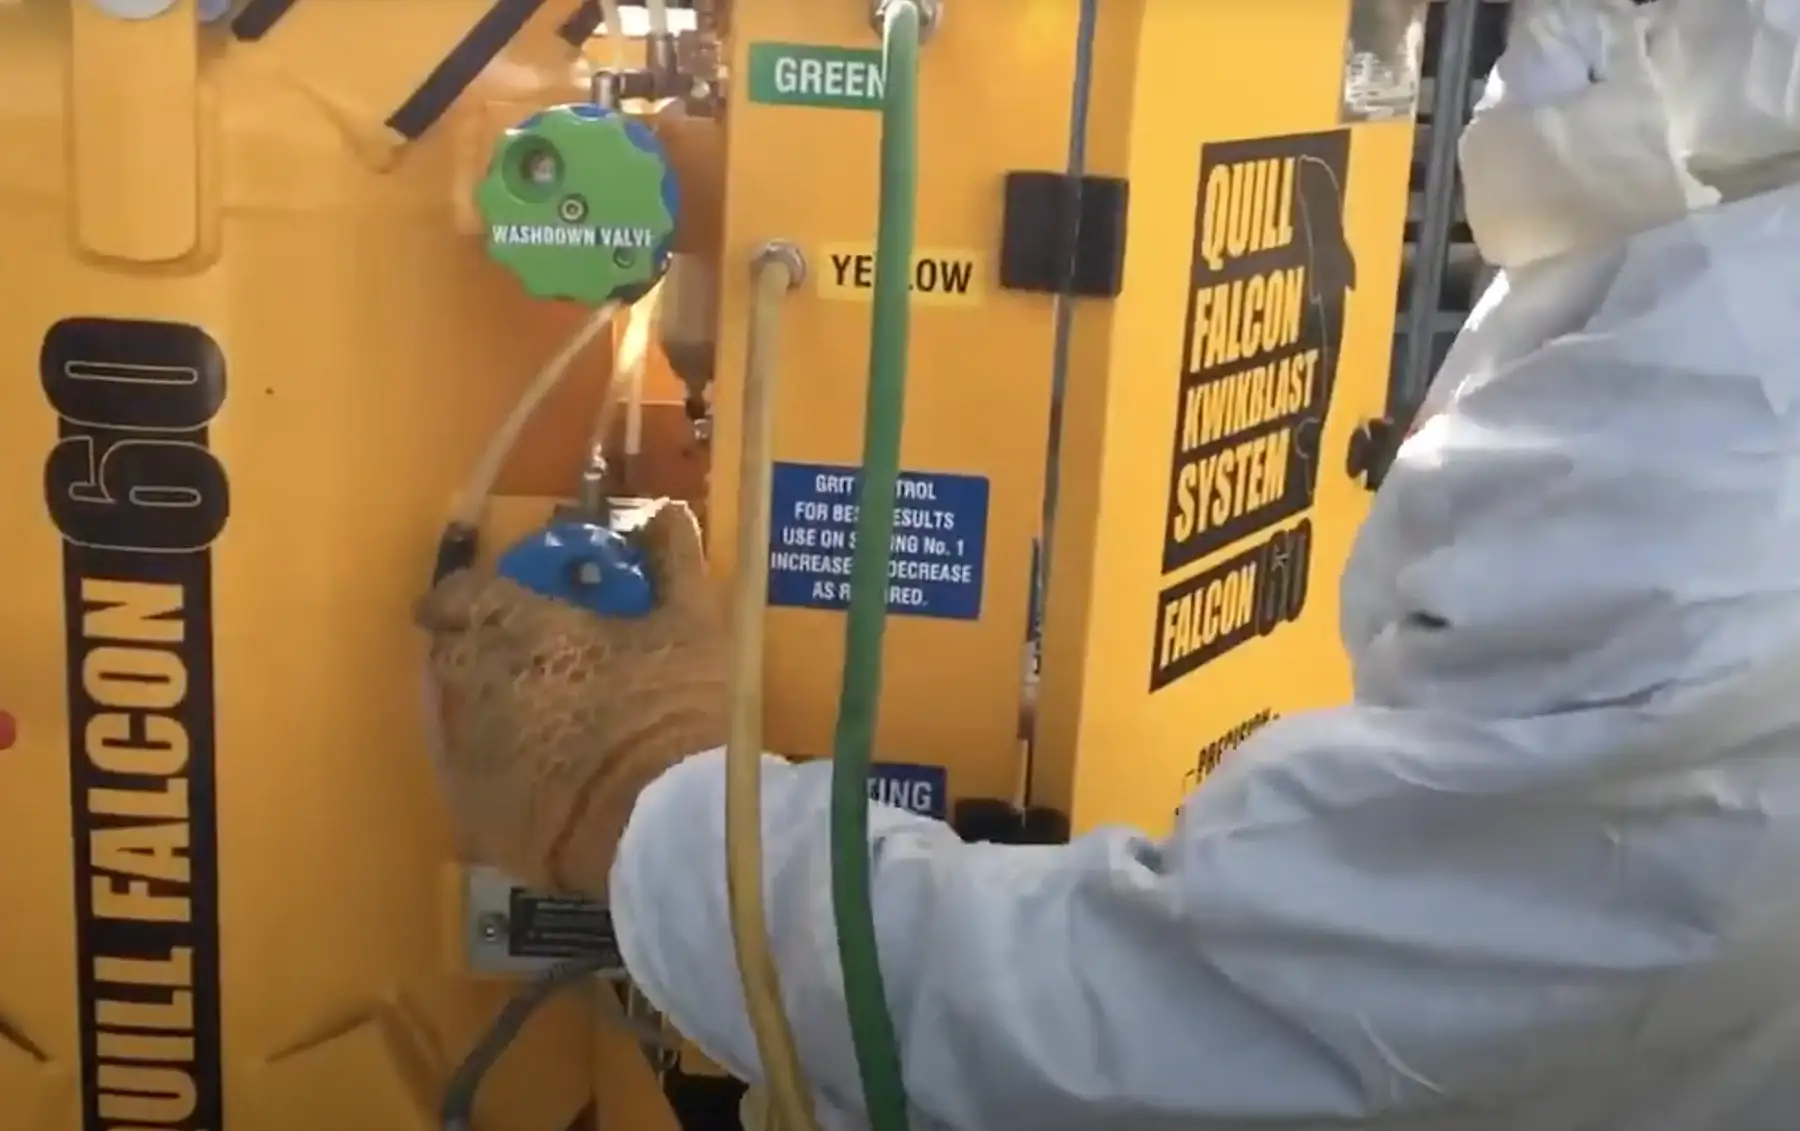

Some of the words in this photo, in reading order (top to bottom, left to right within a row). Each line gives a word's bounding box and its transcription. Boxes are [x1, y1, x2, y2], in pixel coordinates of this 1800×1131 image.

[774, 56, 886, 100] GREEN
[492, 225, 596, 246] WASHDOWN
[1201, 157, 1295, 271] QUILL
[831, 254, 973, 294] YEOW
[1190, 265, 1305, 374] FALCON
[40, 317, 229, 553] 60
[1182, 349, 1319, 452] KWIKBLAST
[794, 501, 828, 523] FOR
[892, 508, 955, 530] ESULTS
[816, 474, 855, 494] GRIT
[1174, 427, 1291, 543] SYSTEM
[771, 552, 853, 575] INCREASE
[887, 560, 972, 583] DECREASE
[782, 526, 816, 546] USE
[821, 529, 845, 549] ON
[923, 537, 951, 556] No.
[957, 539, 965, 556] 1
[812, 581, 834, 601] AS
[1160, 560, 1258, 671] FALCON
[81, 577, 191, 923] FALCON
[93, 945, 198, 1131] UILL
